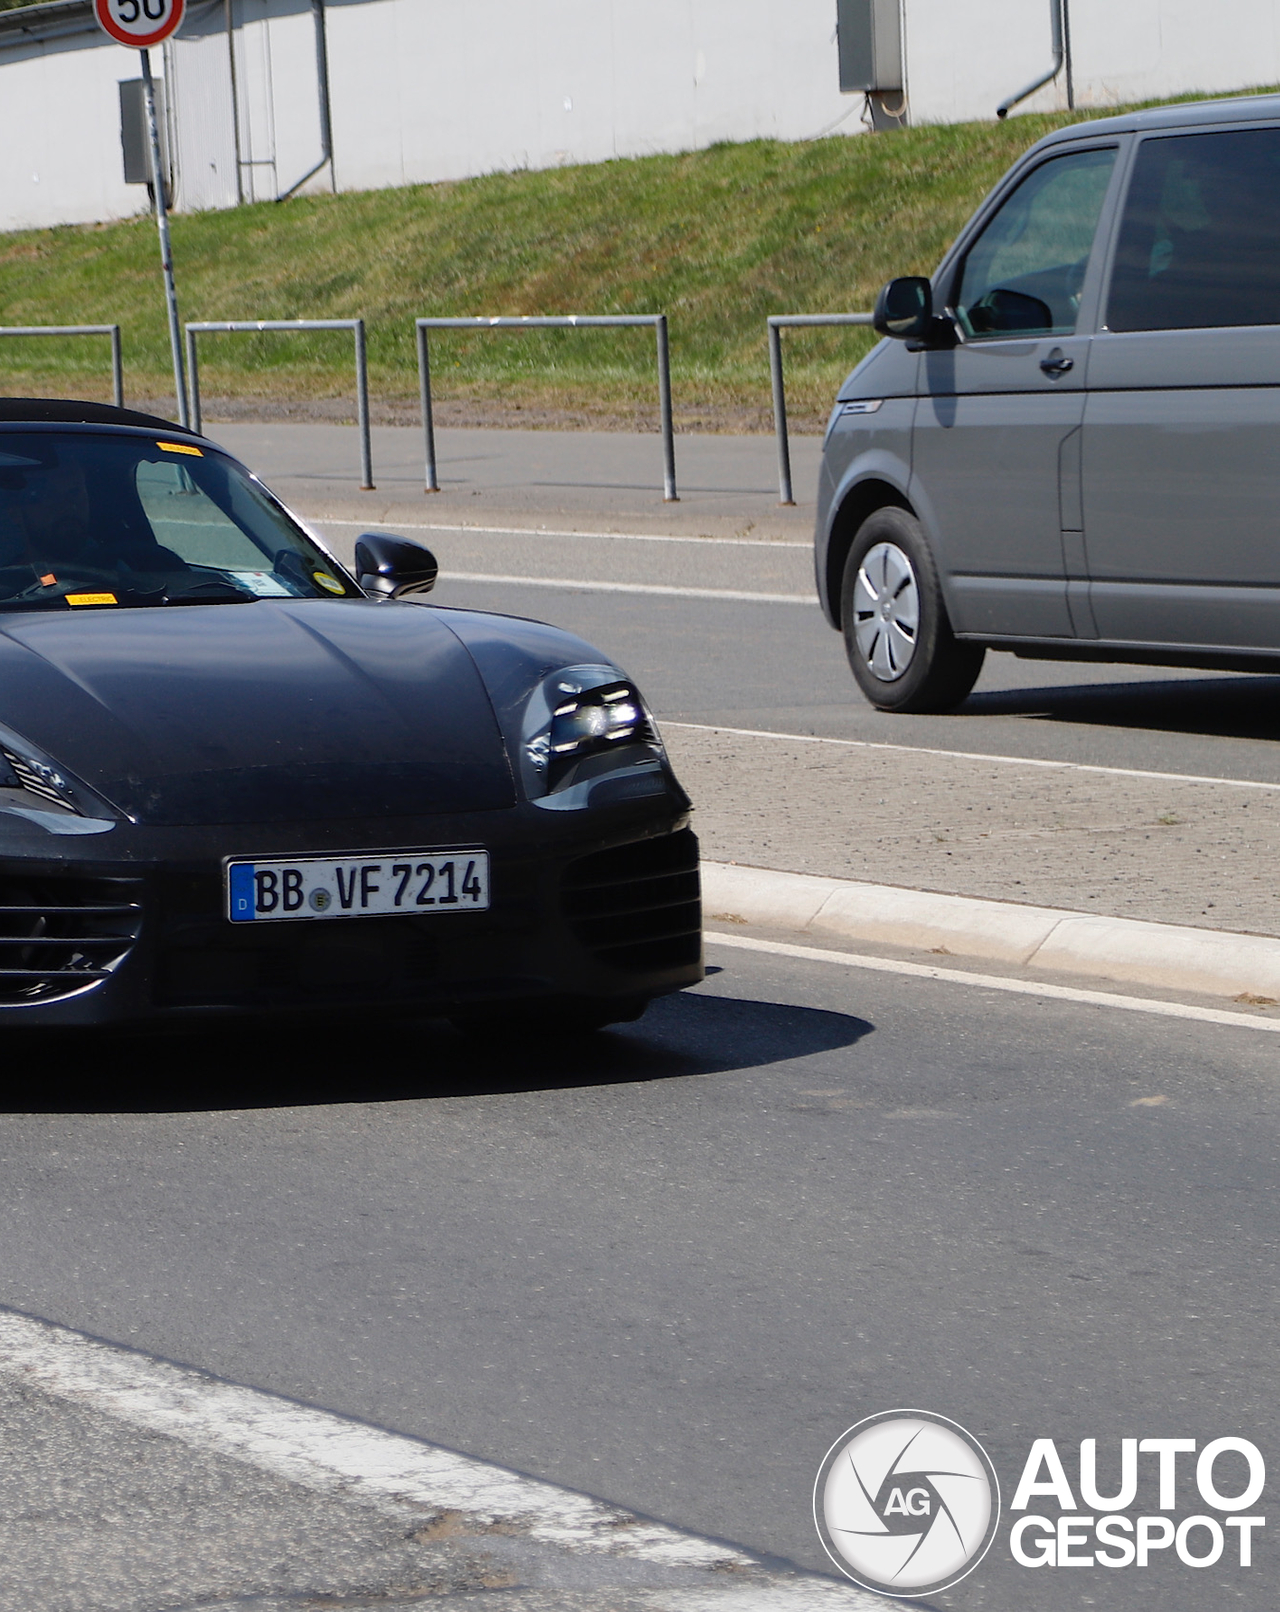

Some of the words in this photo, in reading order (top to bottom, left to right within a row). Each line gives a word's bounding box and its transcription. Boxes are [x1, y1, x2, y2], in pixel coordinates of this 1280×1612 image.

[238, 898, 248, 911] D
[254, 870, 305, 912] BB
[336, 865, 381, 909] VF
[392, 860, 482, 906] 7214
